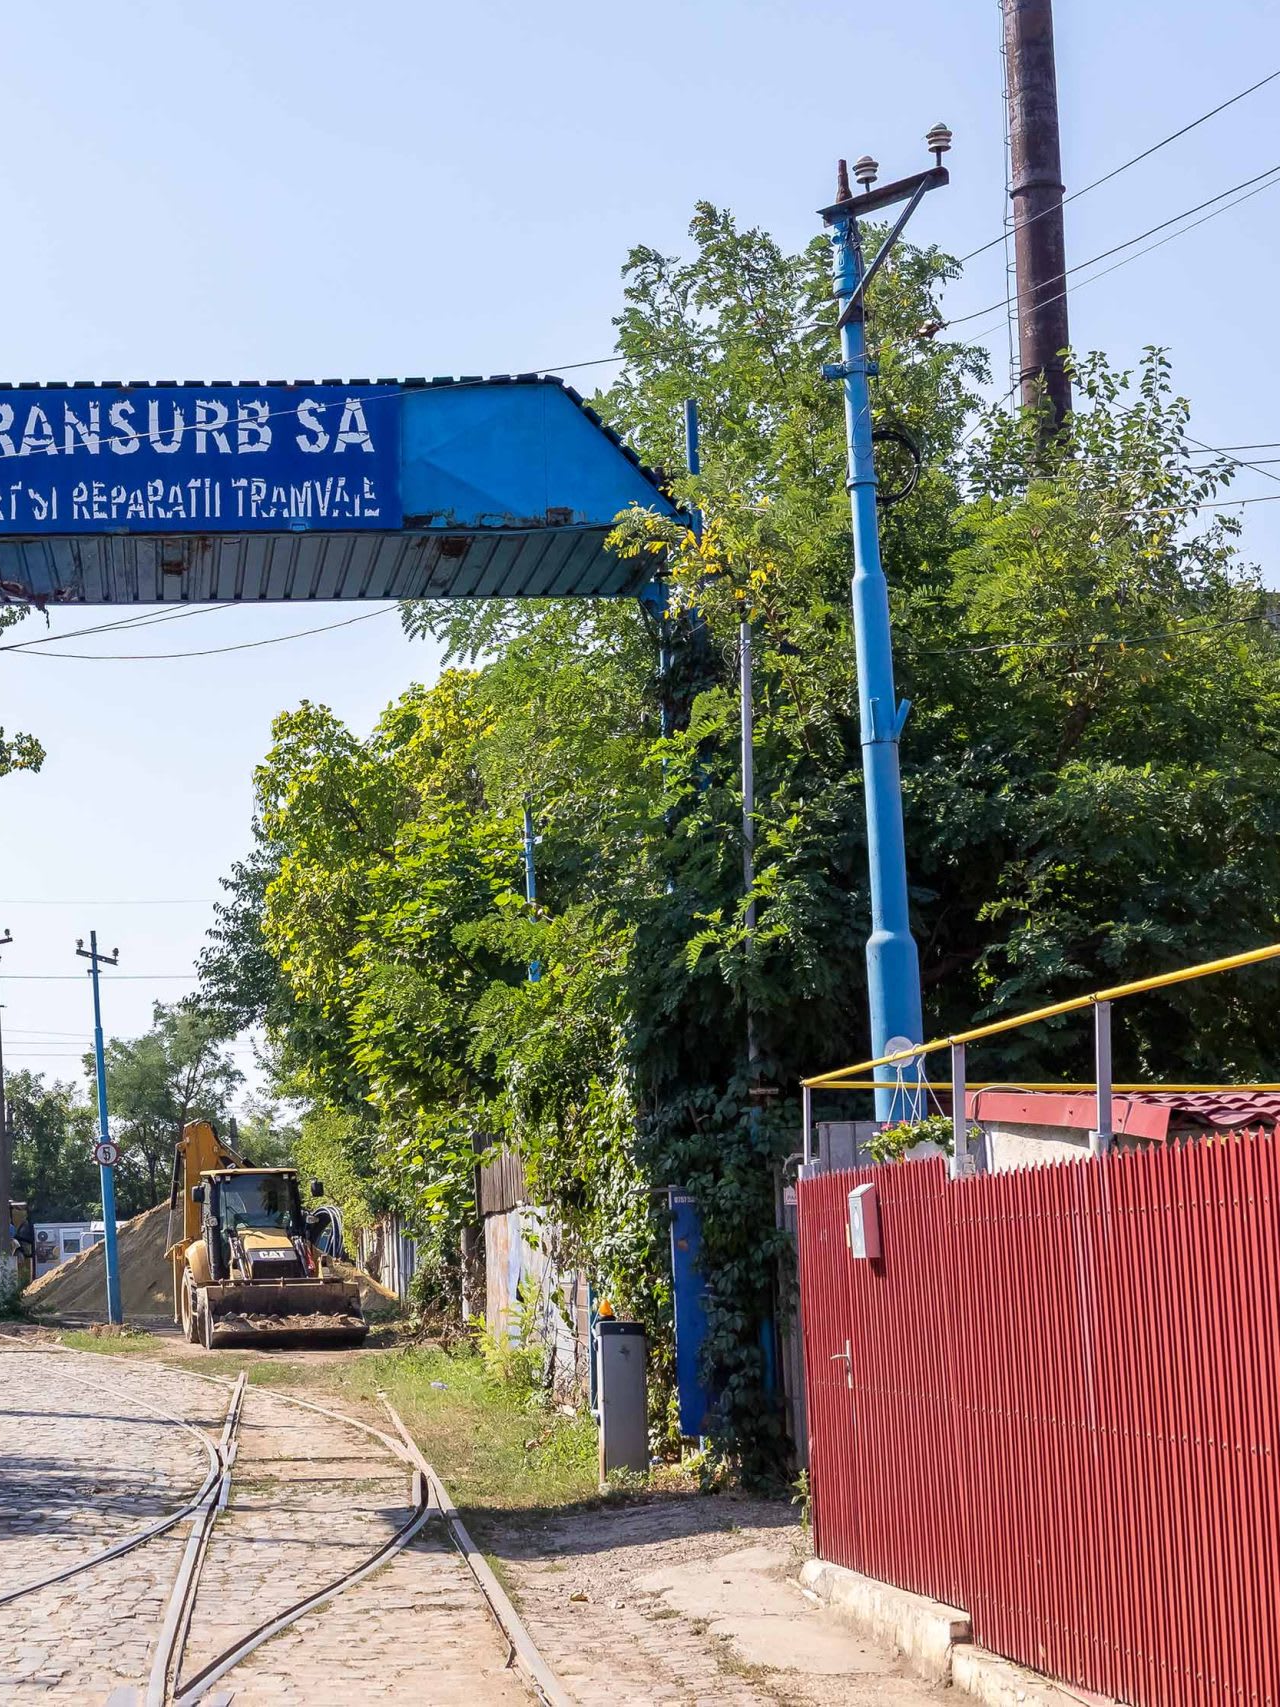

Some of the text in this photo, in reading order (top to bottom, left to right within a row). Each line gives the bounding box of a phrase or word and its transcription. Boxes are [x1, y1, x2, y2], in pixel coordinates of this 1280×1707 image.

[295, 397, 375, 453] SA
[102, 1146, 111, 1161] 5
[259, 1250, 286, 1259] CAT
